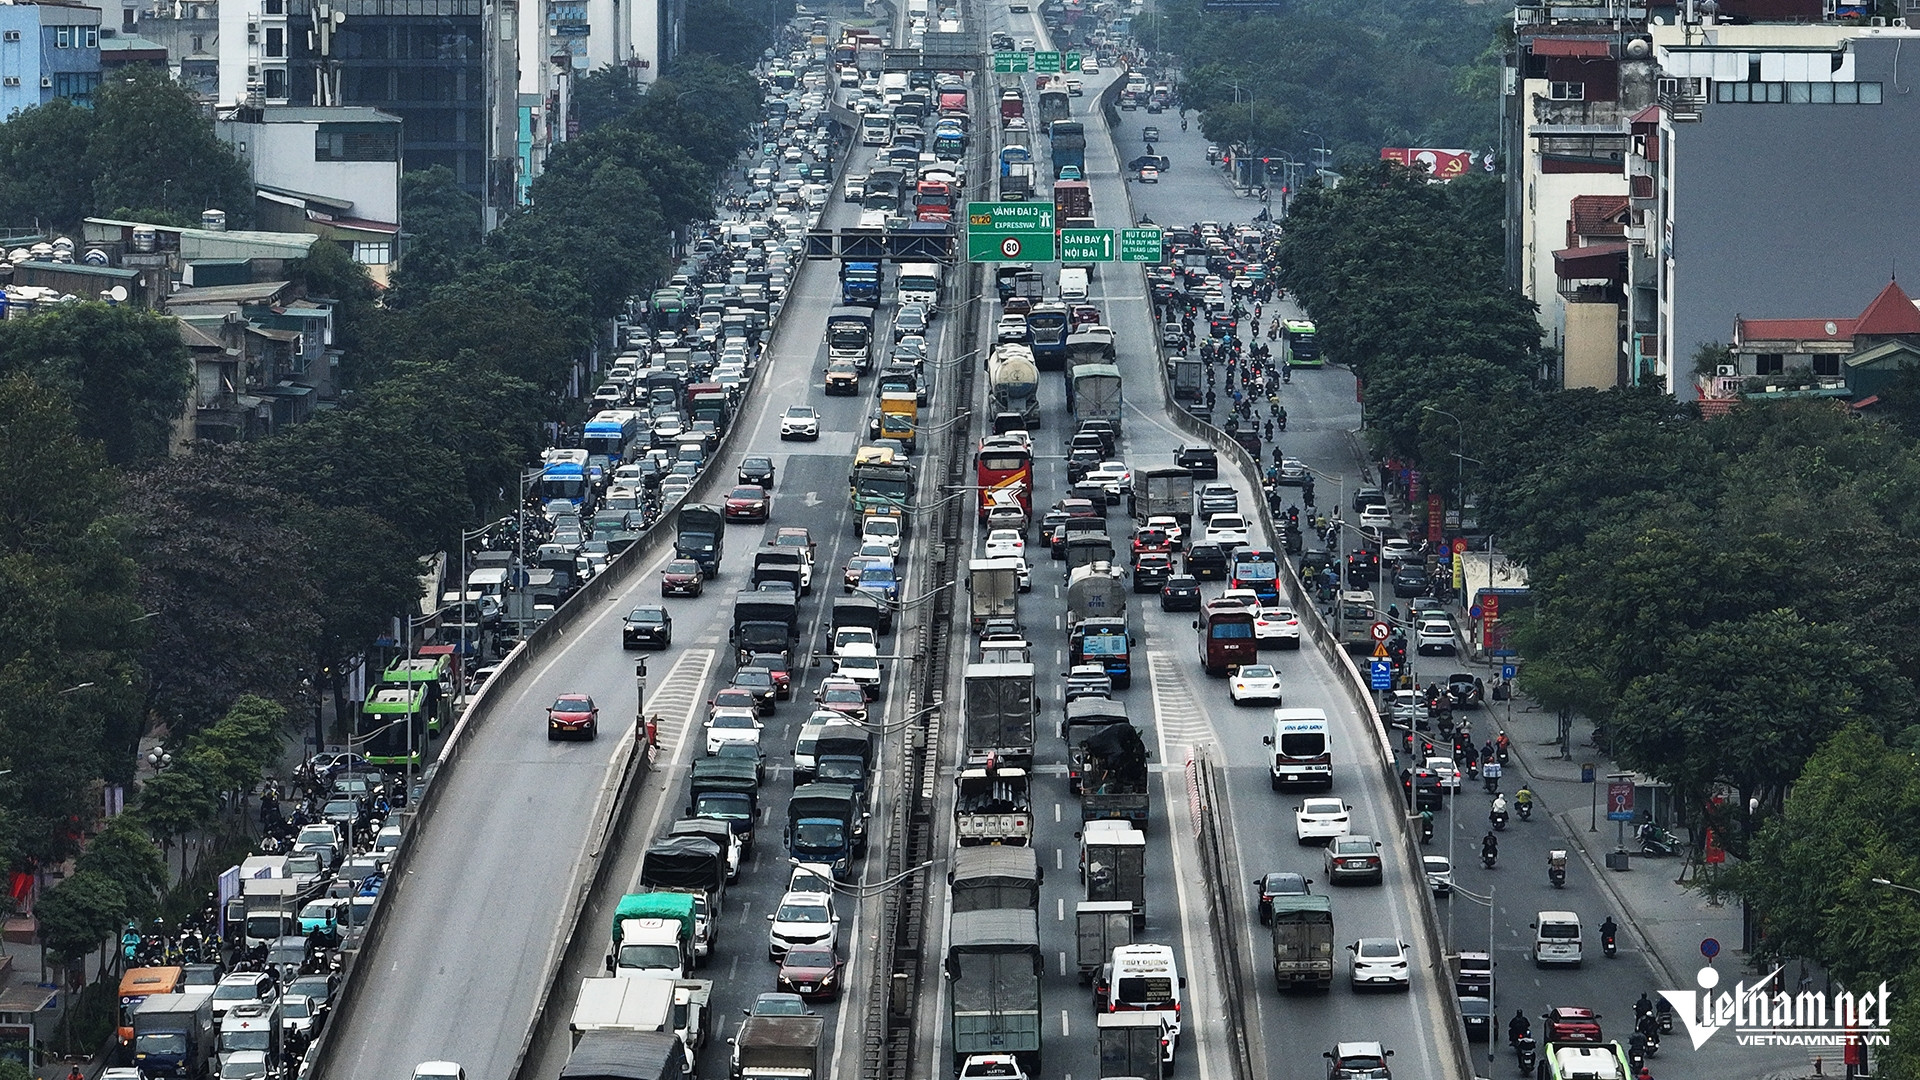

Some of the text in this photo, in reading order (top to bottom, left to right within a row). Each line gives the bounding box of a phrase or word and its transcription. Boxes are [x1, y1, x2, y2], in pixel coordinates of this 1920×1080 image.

[992, 206, 1038, 216] VÀNH ĐAI 3
[1064, 234, 1082, 244] SÂN
[1006, 243, 1017, 252] 80
[1064, 247, 1098, 259] NỘI BÀI
